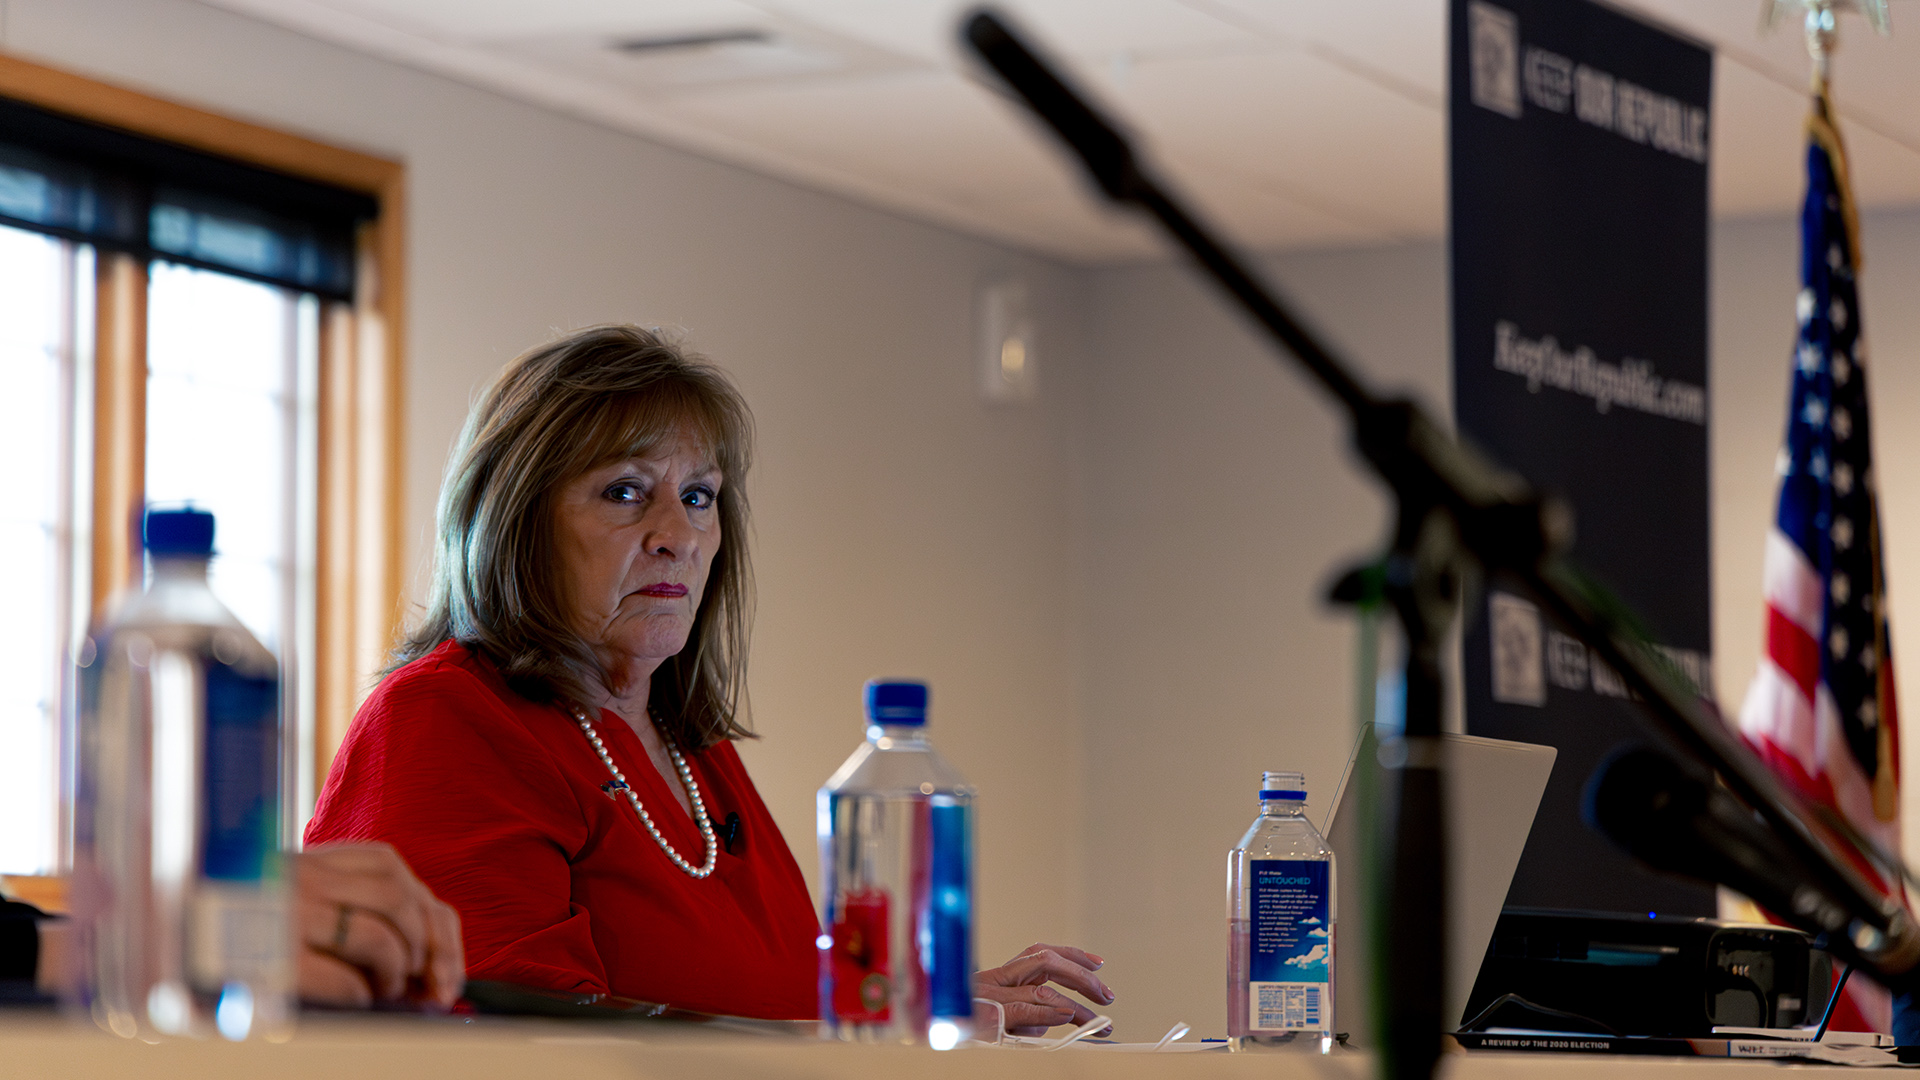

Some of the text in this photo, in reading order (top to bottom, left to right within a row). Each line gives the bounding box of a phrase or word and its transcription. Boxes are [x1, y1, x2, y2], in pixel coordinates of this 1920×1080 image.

[1258, 877, 1311, 885] UNTOUCHED
[1488, 1039, 1519, 1047] REVIEW
[1532, 1040, 1548, 1048] THE
[1570, 1041, 1610, 1049] ELECTION
